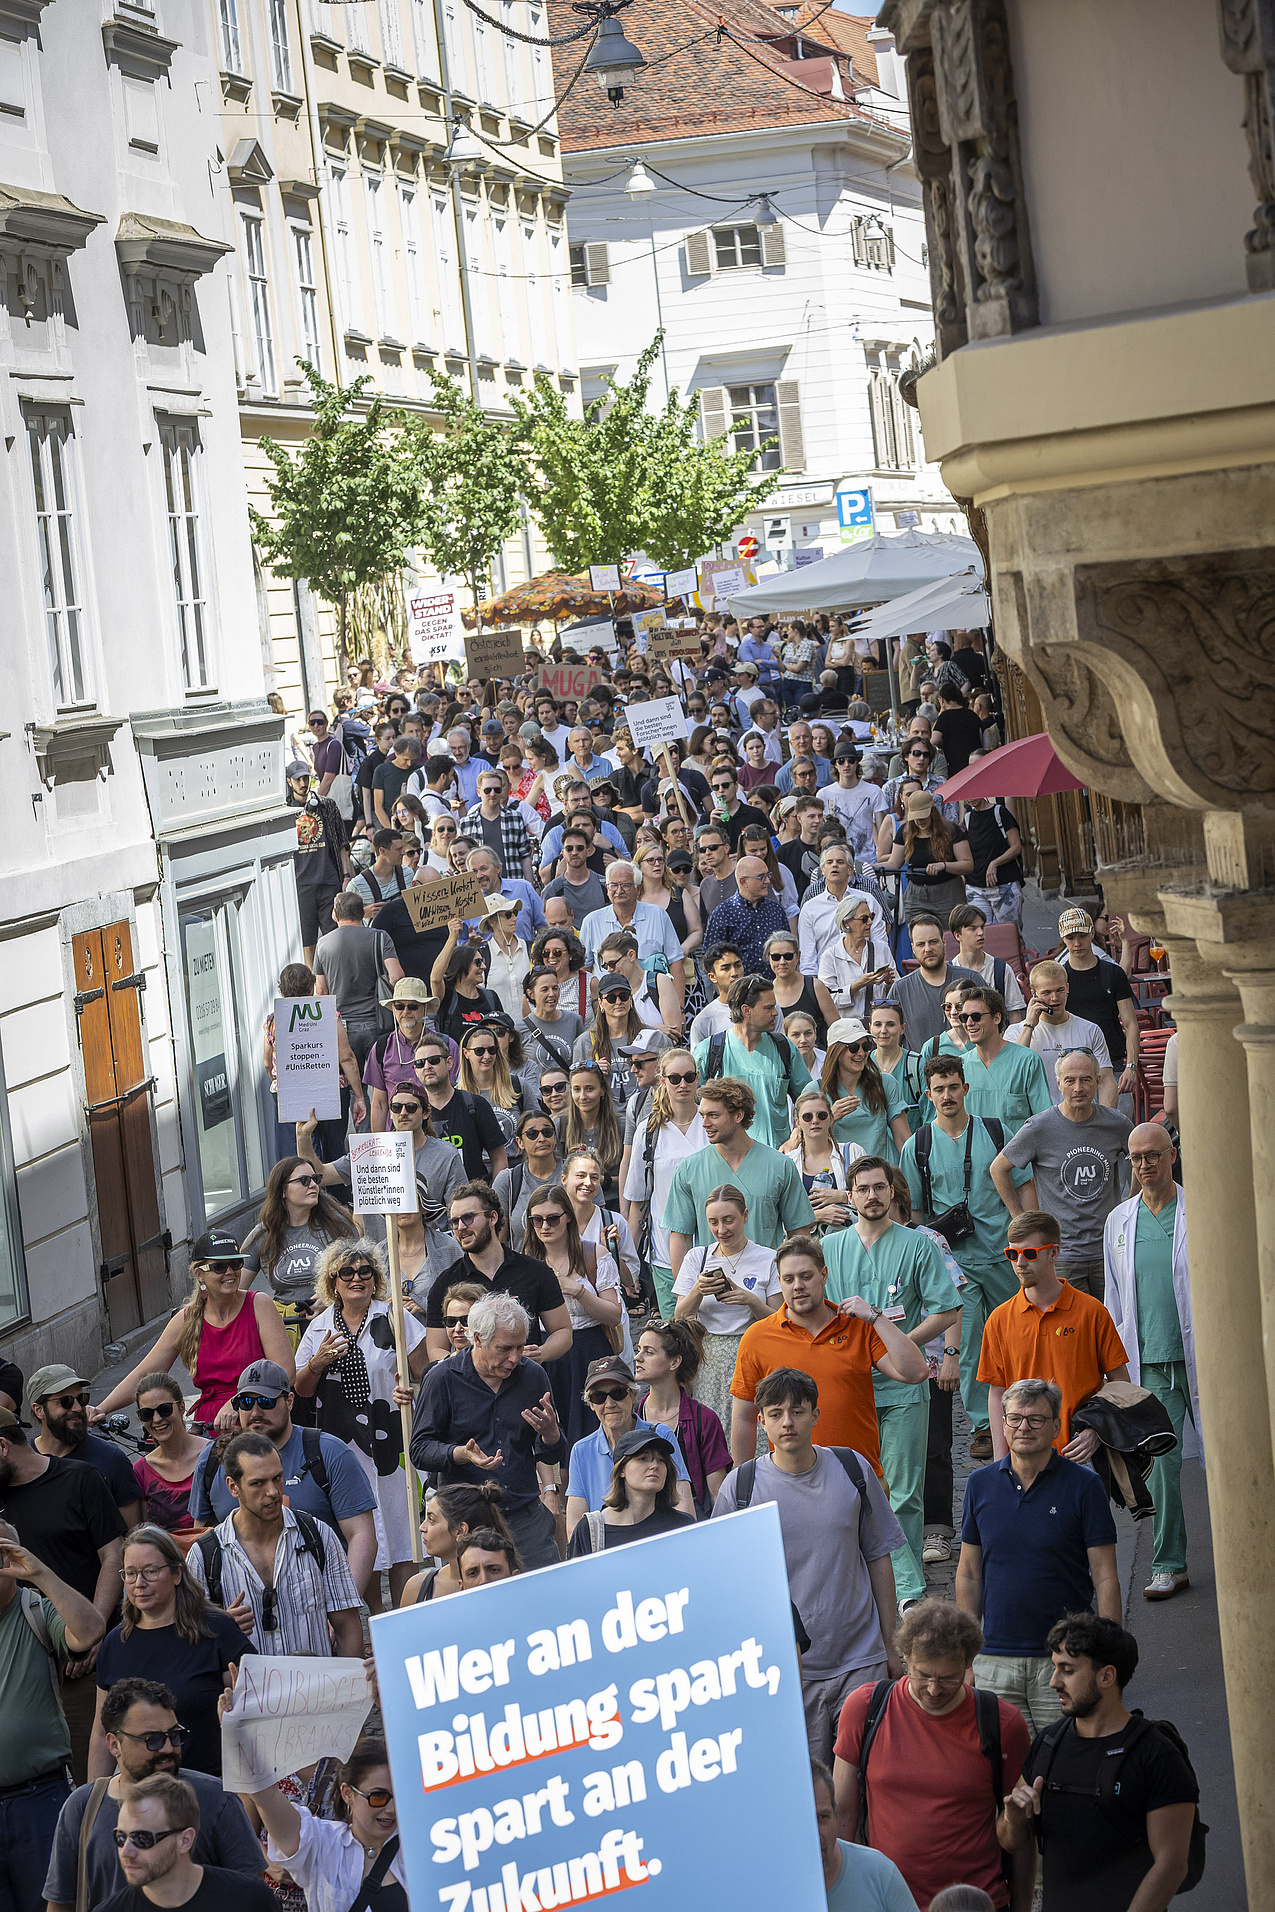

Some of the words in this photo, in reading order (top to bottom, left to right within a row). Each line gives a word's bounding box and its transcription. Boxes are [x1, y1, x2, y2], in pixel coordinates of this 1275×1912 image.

[771, 492, 820, 505] WIESEL
[841, 493, 866, 525] P
[412, 594, 454, 609] WIDER-
[414, 604, 452, 618] STAND
[421, 618, 447, 627] GEGEN
[414, 627, 431, 636] DAS
[432, 624, 456, 633] SPAR-
[421, 632, 452, 641] DIKTAT!
[430, 645, 447, 654] KSV
[483, 664, 502, 674] sich
[643, 721, 663, 729] besten
[645, 716, 660, 724] dann
[637, 733, 662, 743] plötzlich
[291, 1042, 323, 1051] Sparkurs
[290, 1053, 320, 1061] stoppen
[285, 1062, 331, 1071] #UnisRetten
[1066, 1146, 1104, 1160] PIONEERING
[356, 1164, 369, 1174] Und
[370, 1164, 387, 1174] dann
[387, 1163, 401, 1173] sind
[356, 1175, 367, 1184] die
[367, 1174, 389, 1184] besten
[358, 1196, 387, 1208] plötzlich
[387, 1197, 401, 1207] weg
[404, 1638, 516, 1710] Wer
[526, 1618, 593, 1676] an
[601, 1586, 690, 1653] der
[243, 1666, 283, 1715] NO
[292, 1670, 370, 1715] BUDGET
[417, 1682, 624, 1790] Bildung
[629, 1636, 782, 1732] spart,
[283, 1723, 355, 1763] BRAINS
[429, 1774, 576, 1871] spart
[582, 1759, 648, 1818] an
[655, 1726, 743, 1794] der
[438, 1828, 664, 1912] Zukunft.
